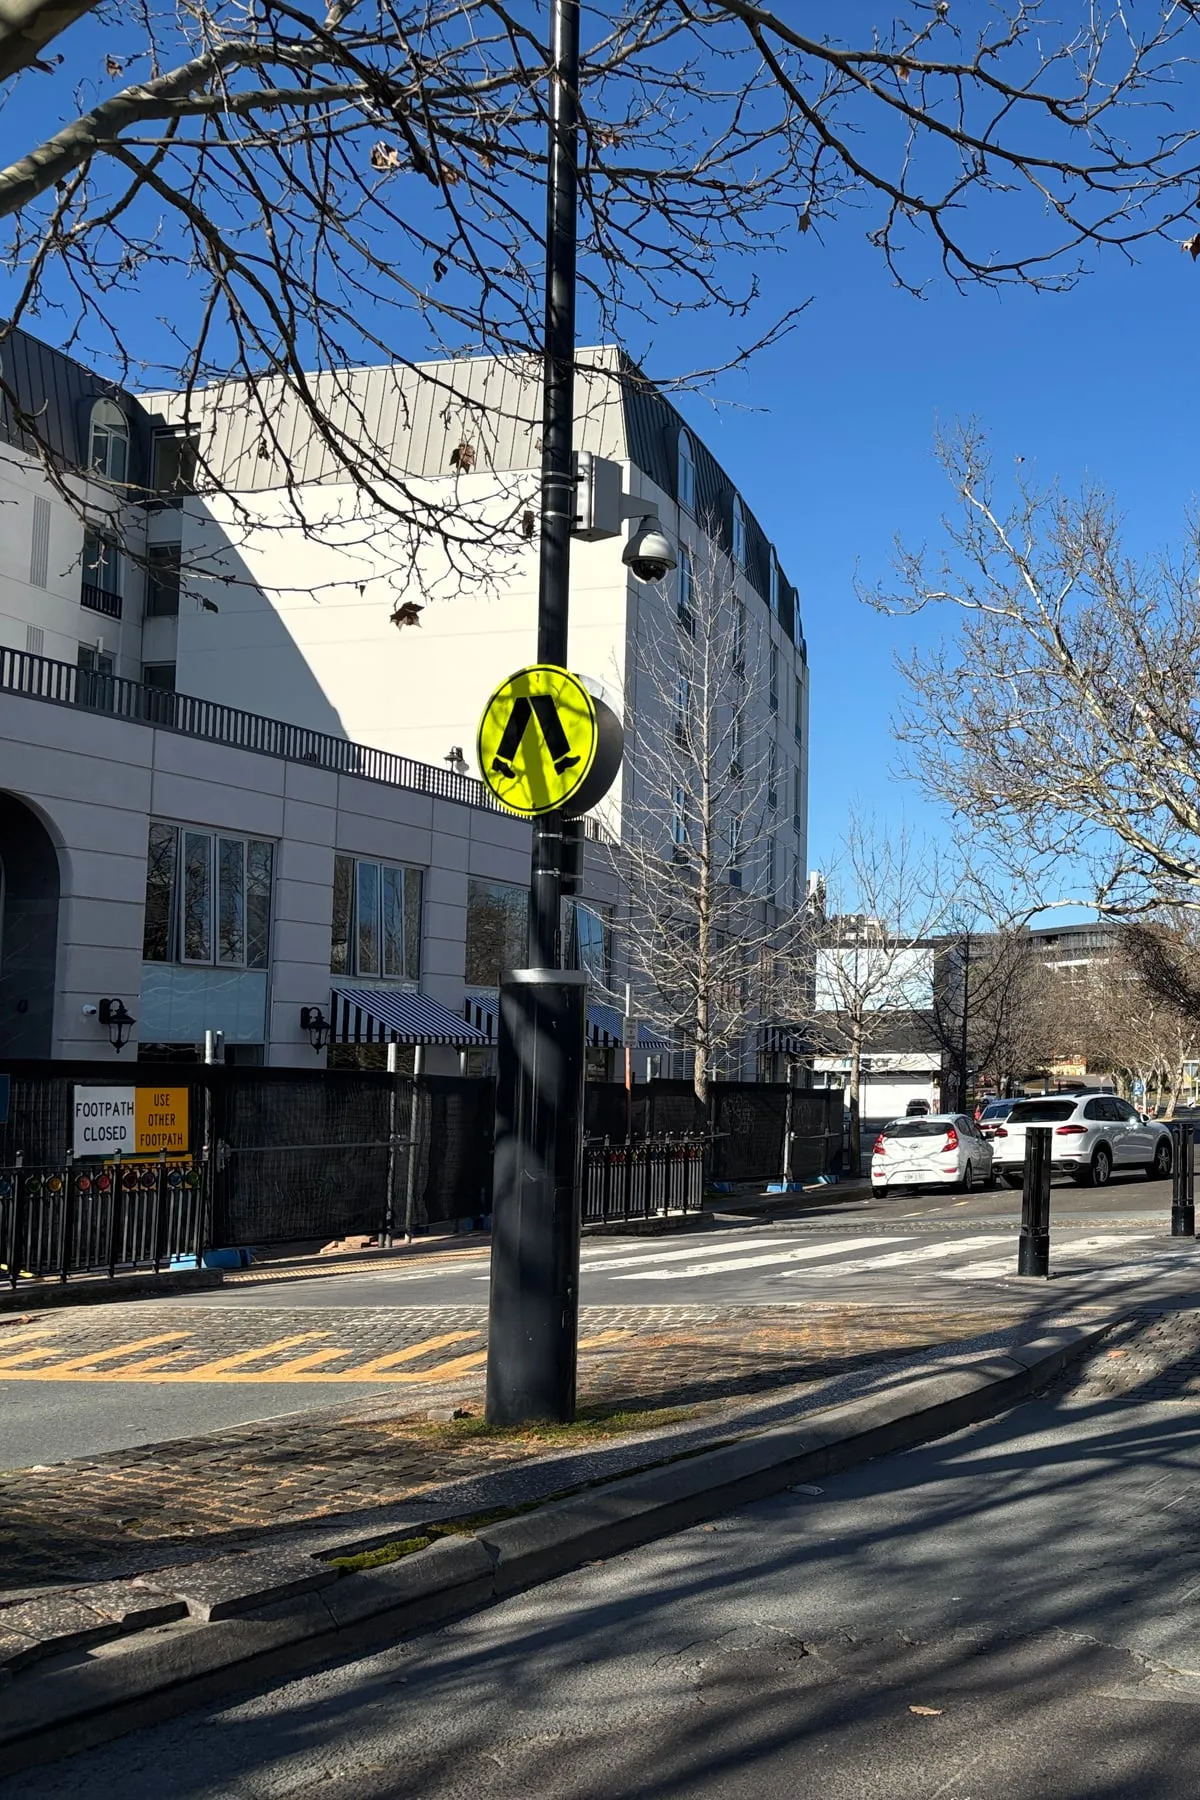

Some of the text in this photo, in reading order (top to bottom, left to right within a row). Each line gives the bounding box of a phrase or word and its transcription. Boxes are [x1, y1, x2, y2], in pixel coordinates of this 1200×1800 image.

[154, 1094, 170, 1107] USE
[76, 1101, 134, 1117] FOOTPATH
[148, 1113, 176, 1127] OTHER
[84, 1126, 127, 1142] CLOSED
[140, 1132, 183, 1147] FOOTPATH
